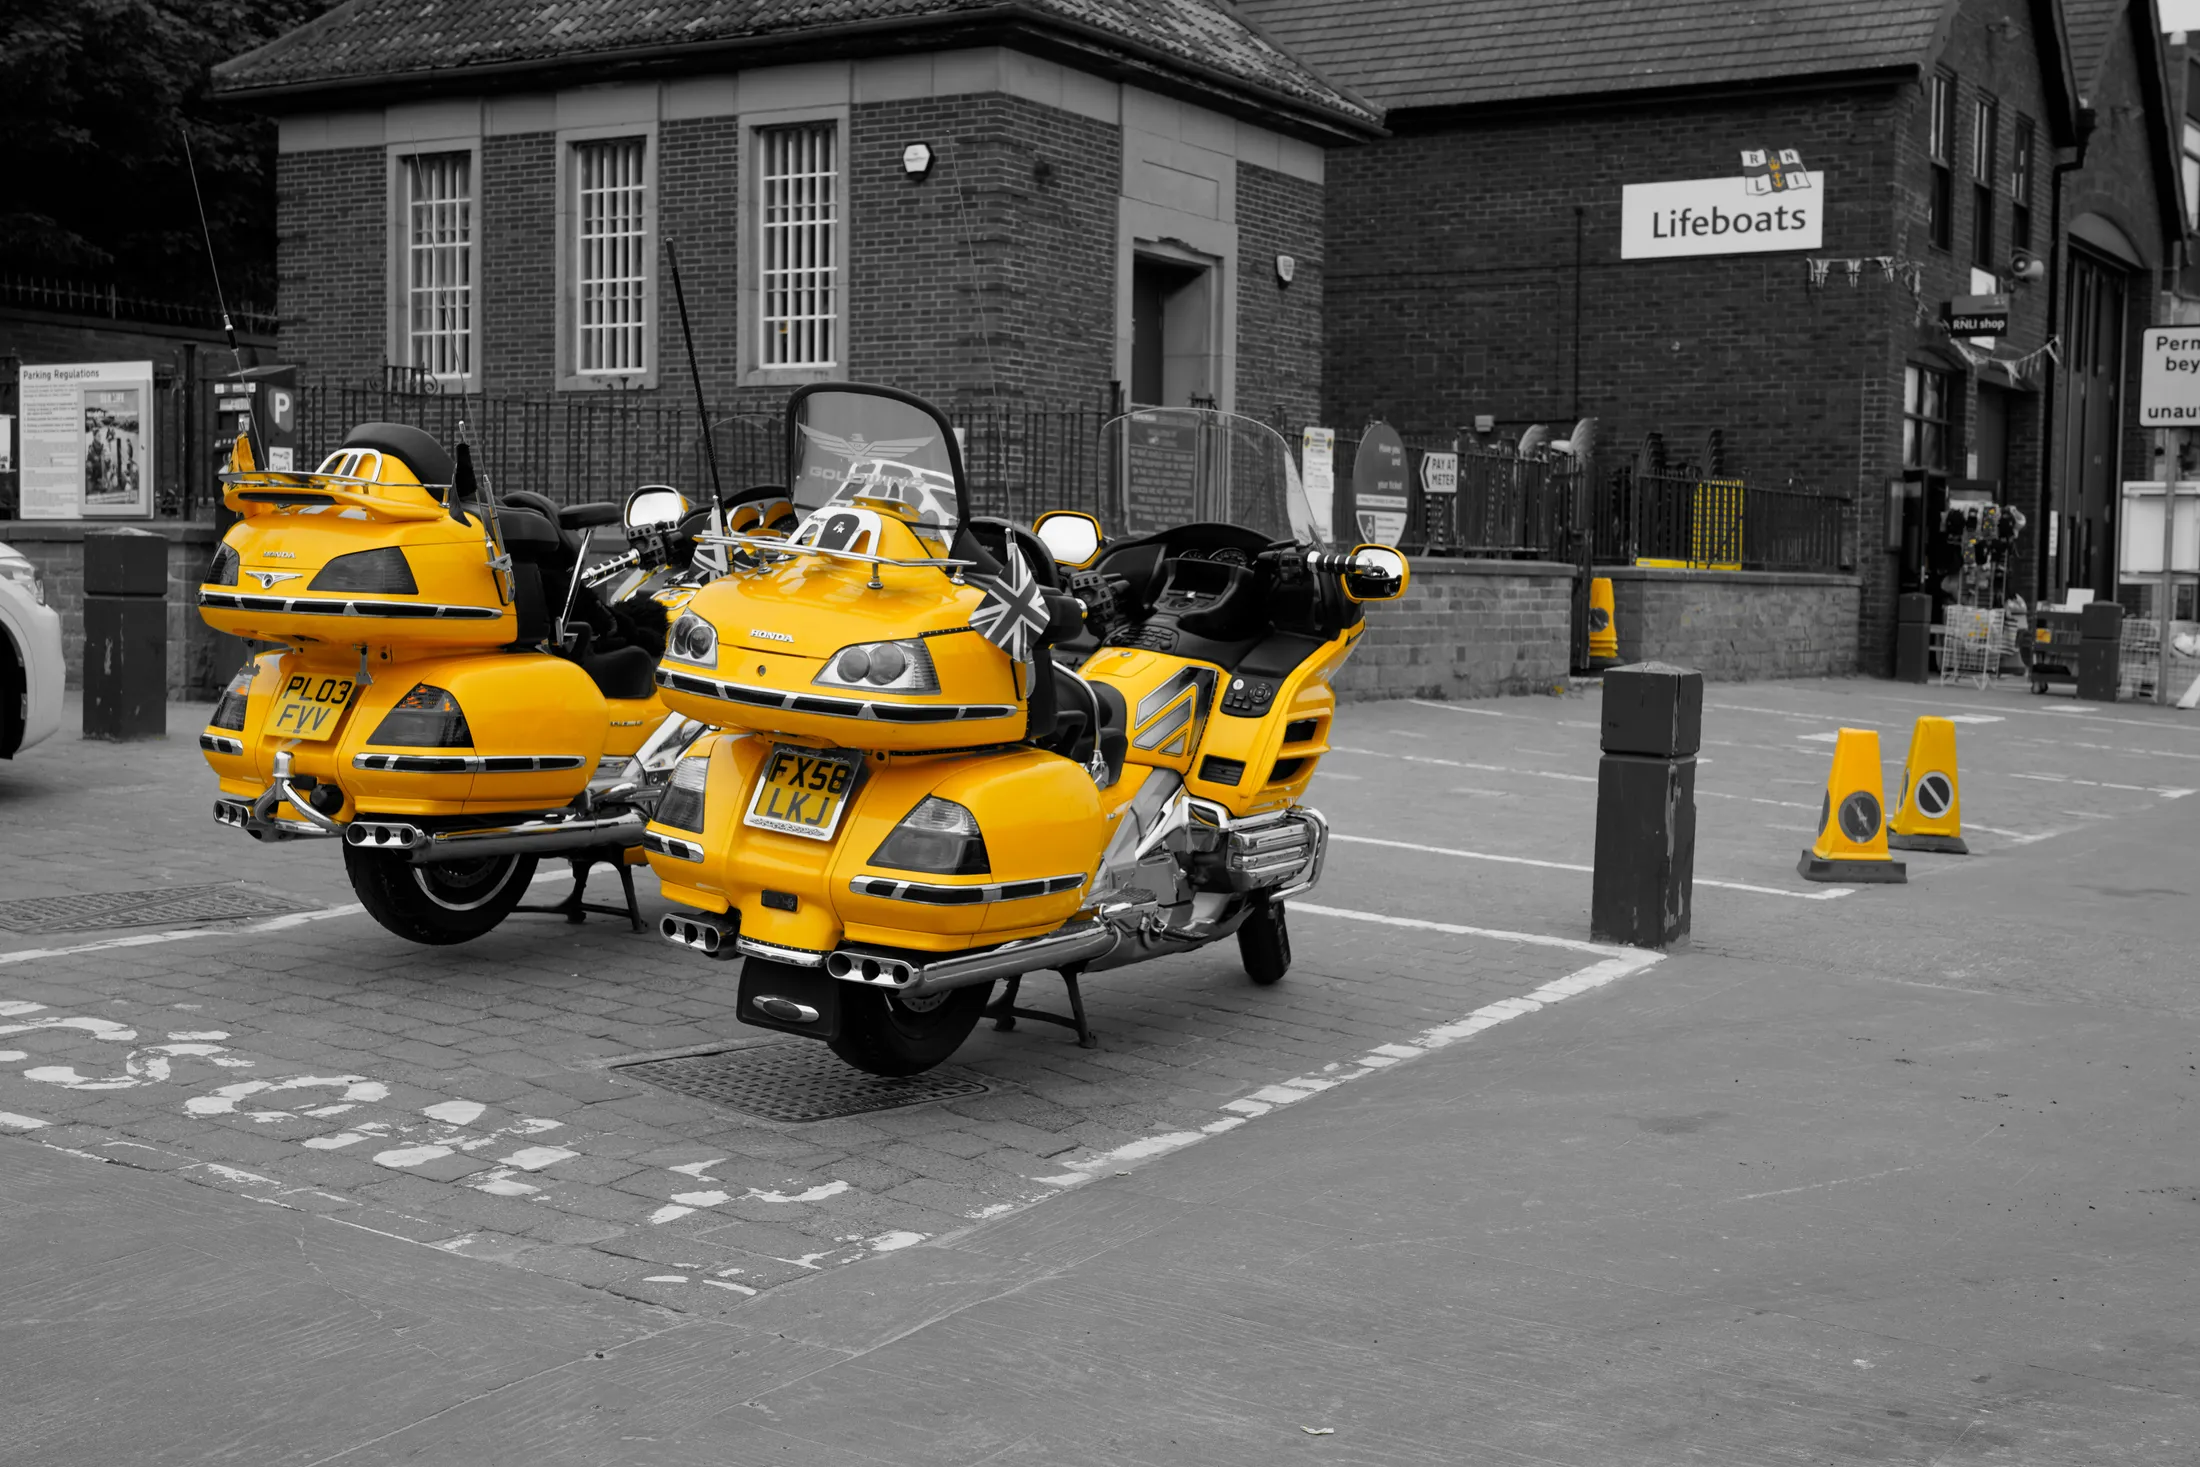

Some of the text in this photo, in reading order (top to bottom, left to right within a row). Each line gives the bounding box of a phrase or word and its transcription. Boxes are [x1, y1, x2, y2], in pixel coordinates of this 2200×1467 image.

[1653, 205, 1806, 239] Lifeboats
[1953, 317, 2005, 332] RNLI shop
[23, 368, 100, 380] Parking Regulations
[275, 392, 290, 424] P
[2148, 405, 2200, 419] unau
[1432, 457, 1456, 470] PAY AT
[1432, 473, 1455, 486] METER
[263, 551, 296, 559] HONDA
[750, 629, 794, 643] HONDA
[283, 676, 353, 705] PL03
[769, 753, 851, 794] FX58
[766, 788, 830, 826] LKJ
